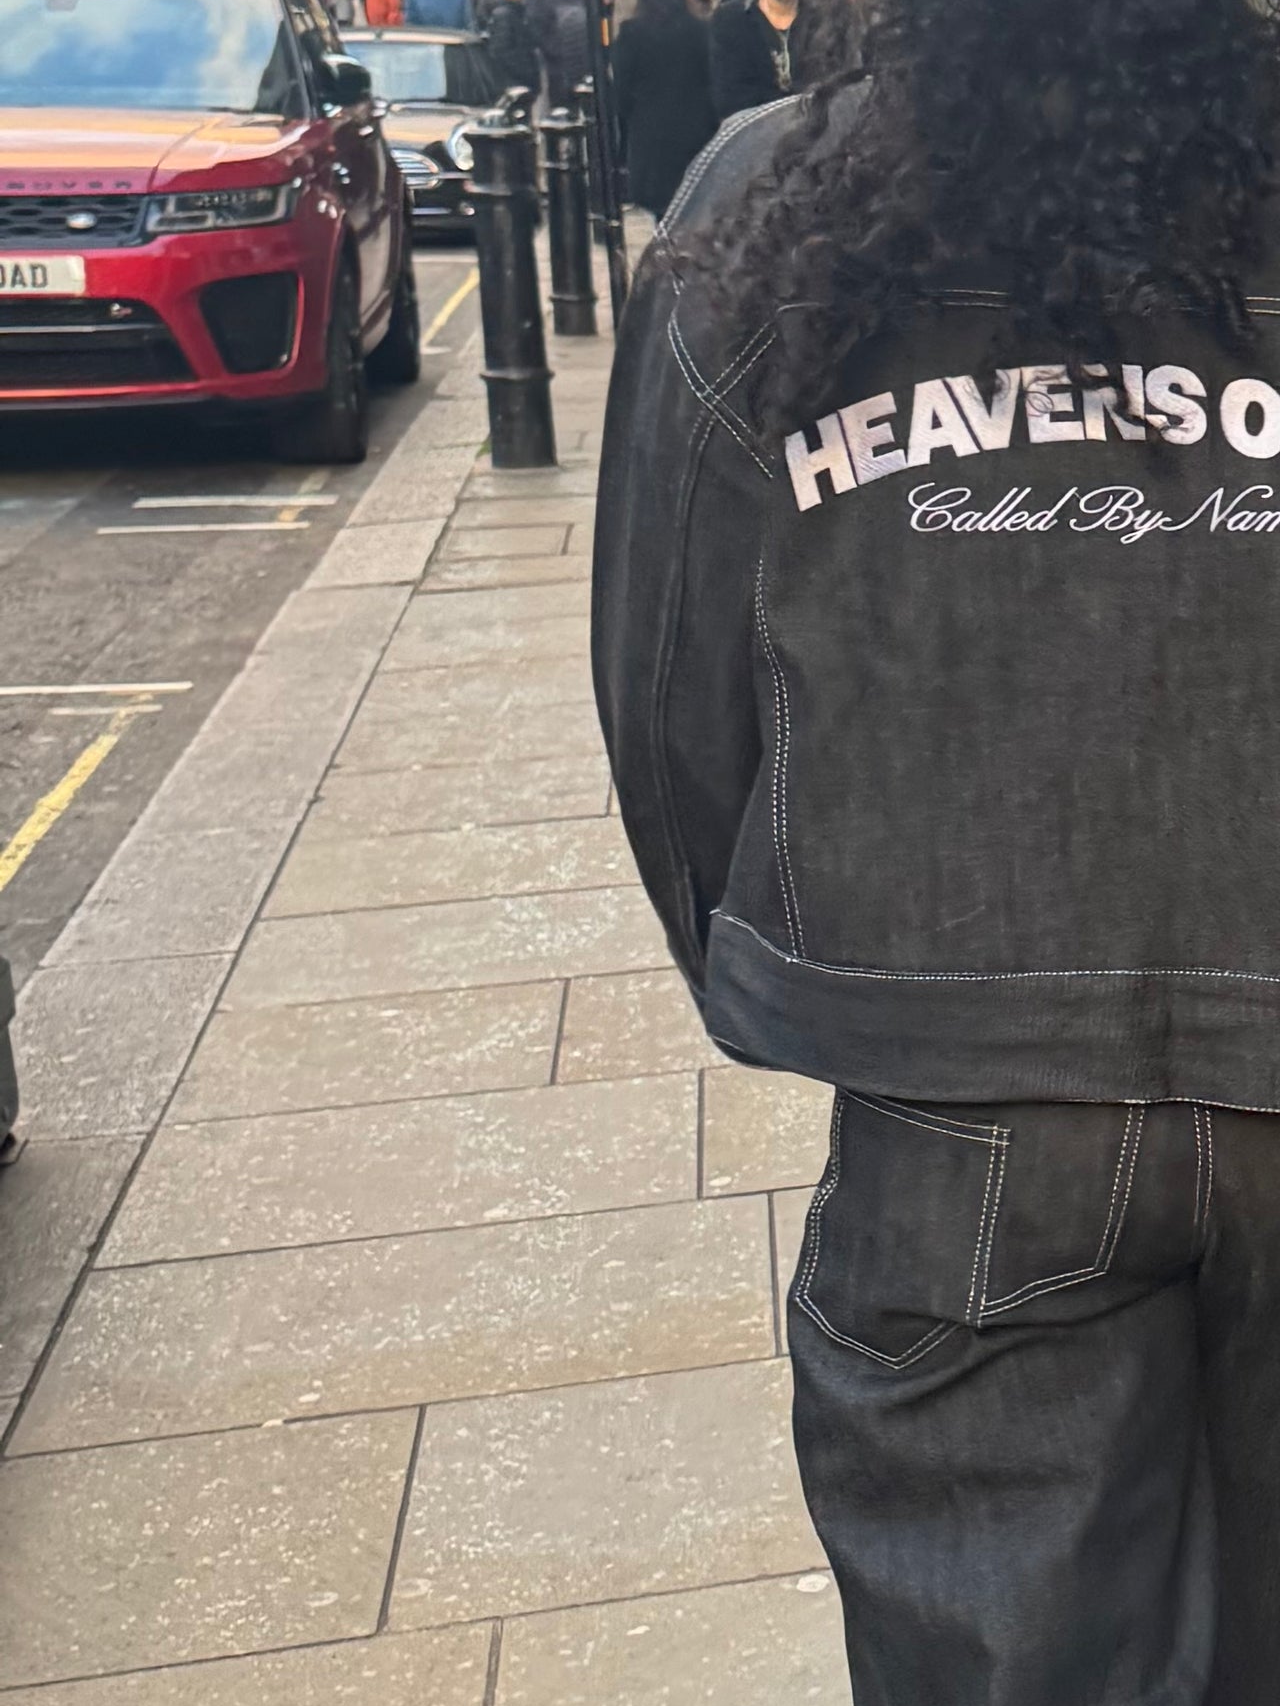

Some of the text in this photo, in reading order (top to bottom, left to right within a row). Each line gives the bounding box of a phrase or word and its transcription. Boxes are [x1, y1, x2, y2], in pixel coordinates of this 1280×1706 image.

[785, 364, 1208, 512] HEAVENS
[907, 482, 1078, 533] Called
[1070, 485, 1161, 545] By
